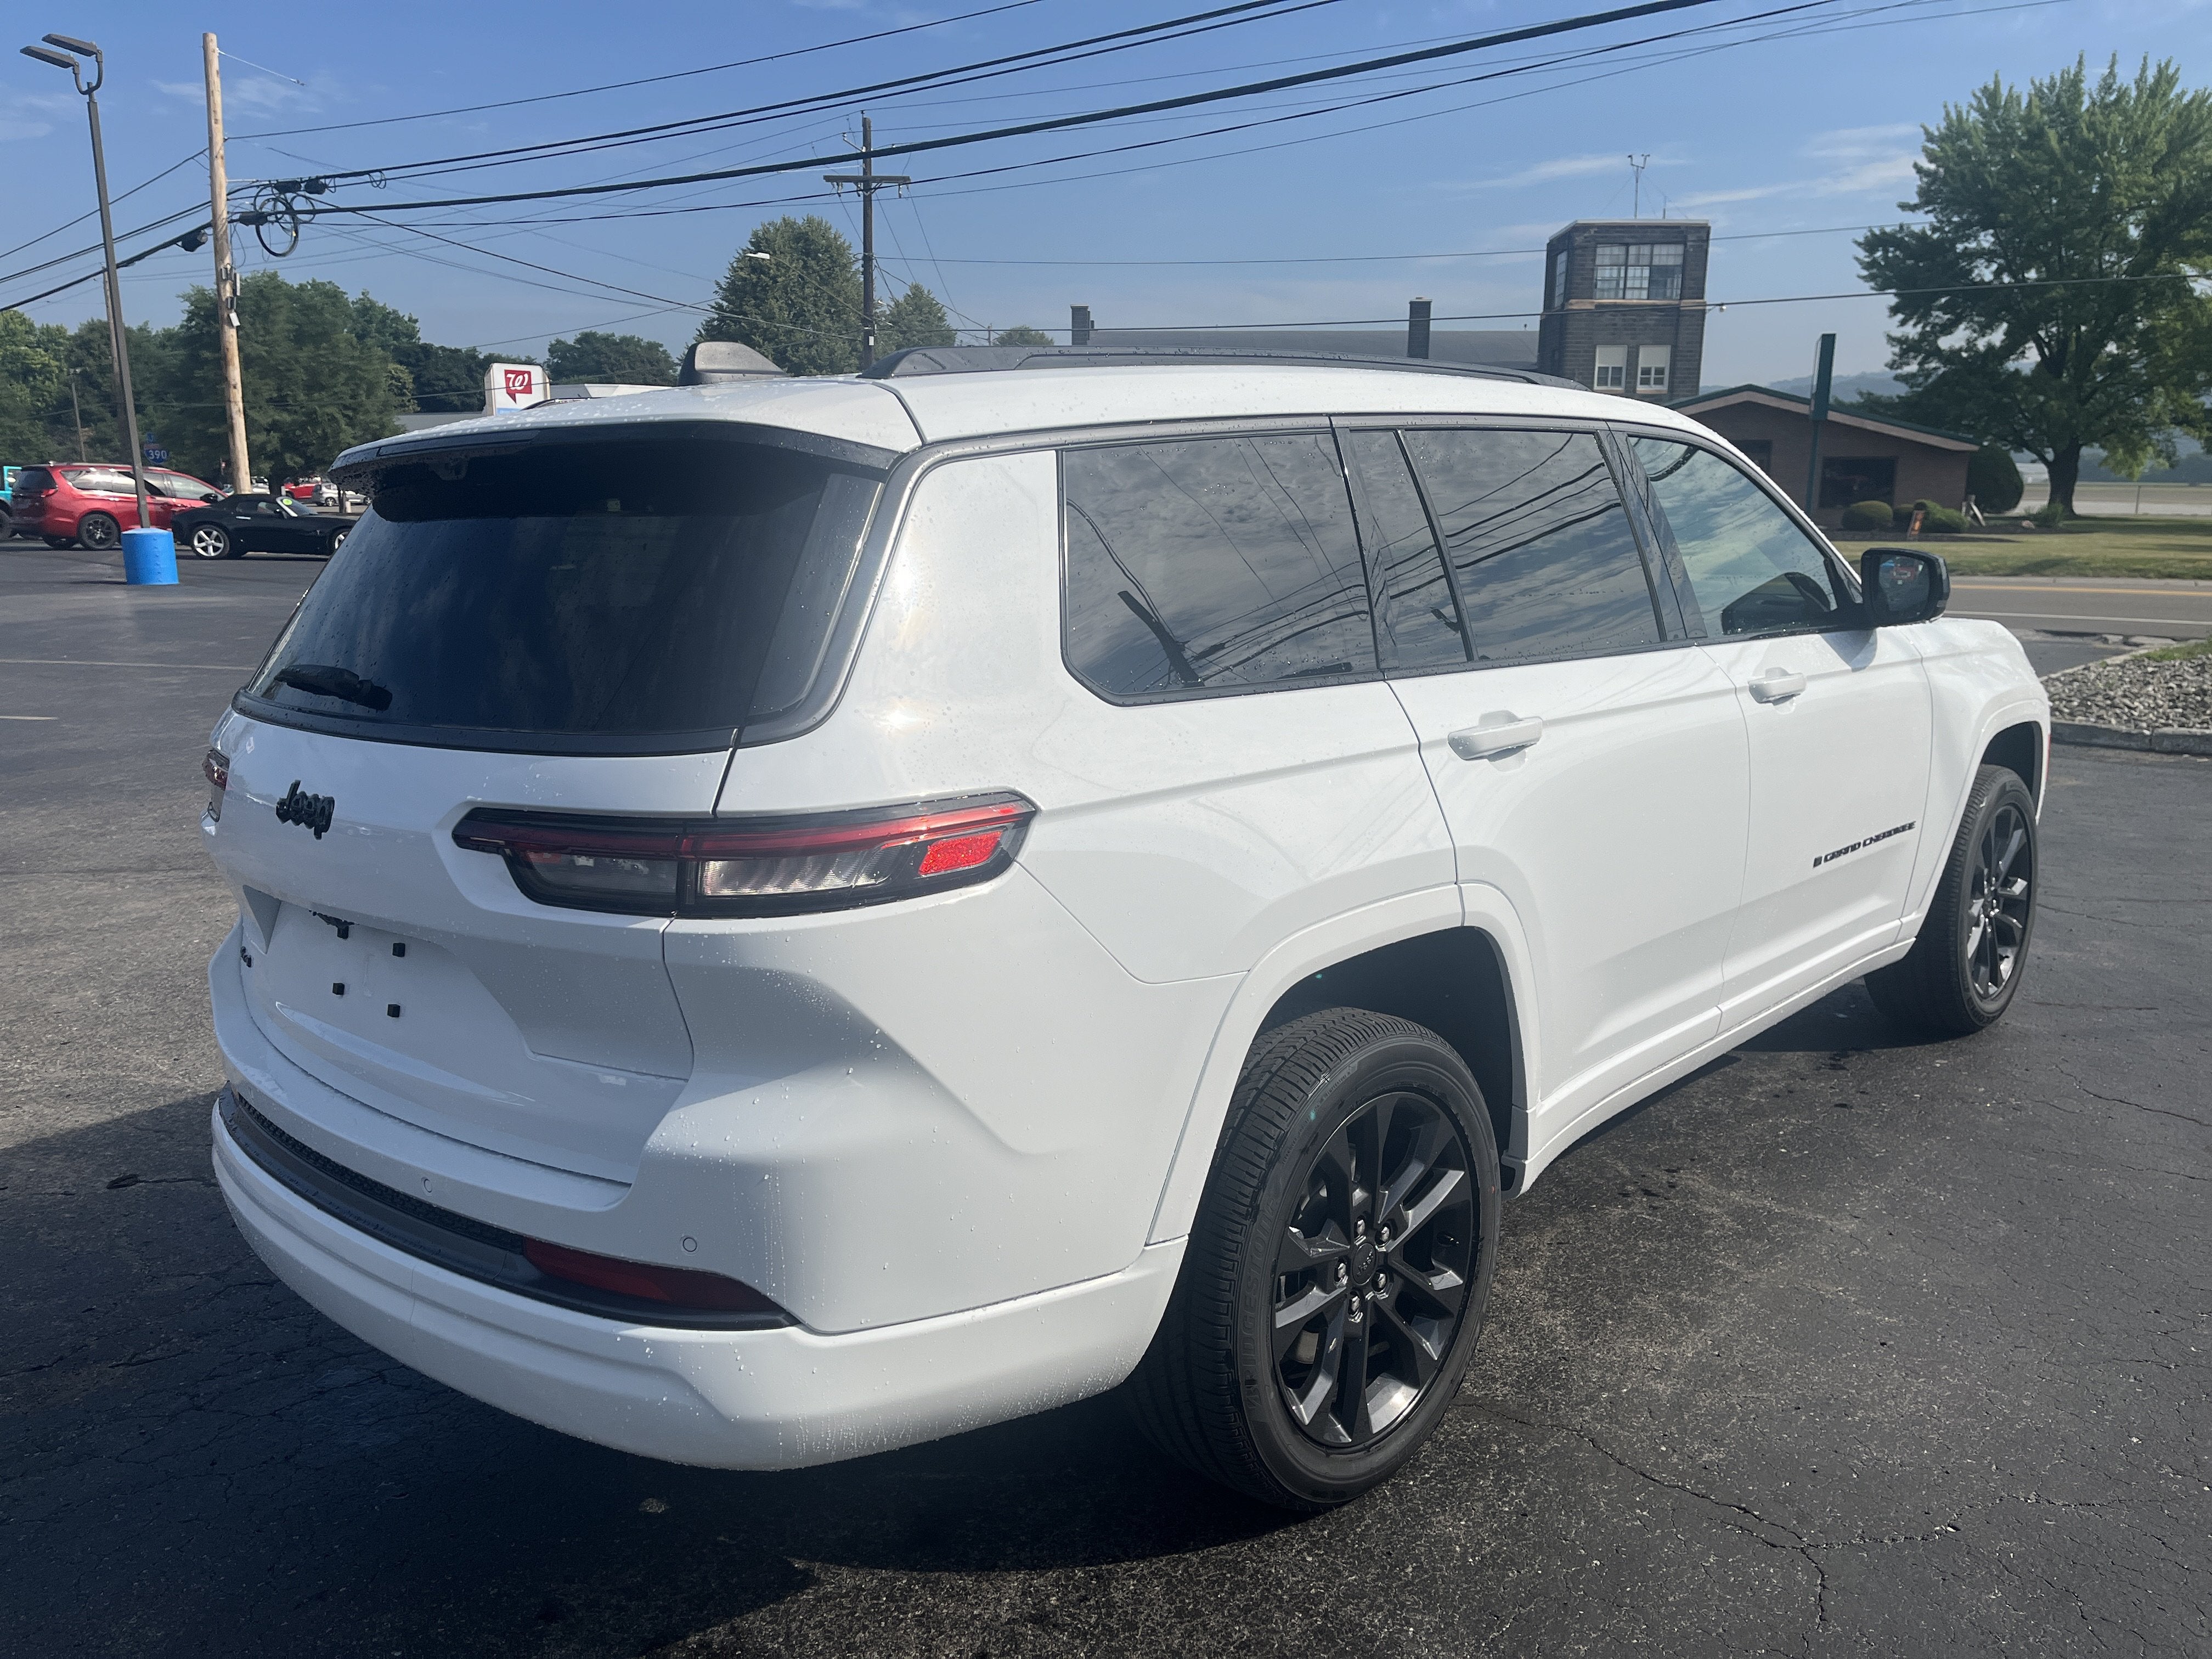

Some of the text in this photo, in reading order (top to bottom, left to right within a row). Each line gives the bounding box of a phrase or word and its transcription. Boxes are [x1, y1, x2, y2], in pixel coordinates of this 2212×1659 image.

[149, 450, 167, 459] 390
[276, 780, 335, 840] Jeep
[1823, 821, 1916, 863] GRAND CHEROKEE
